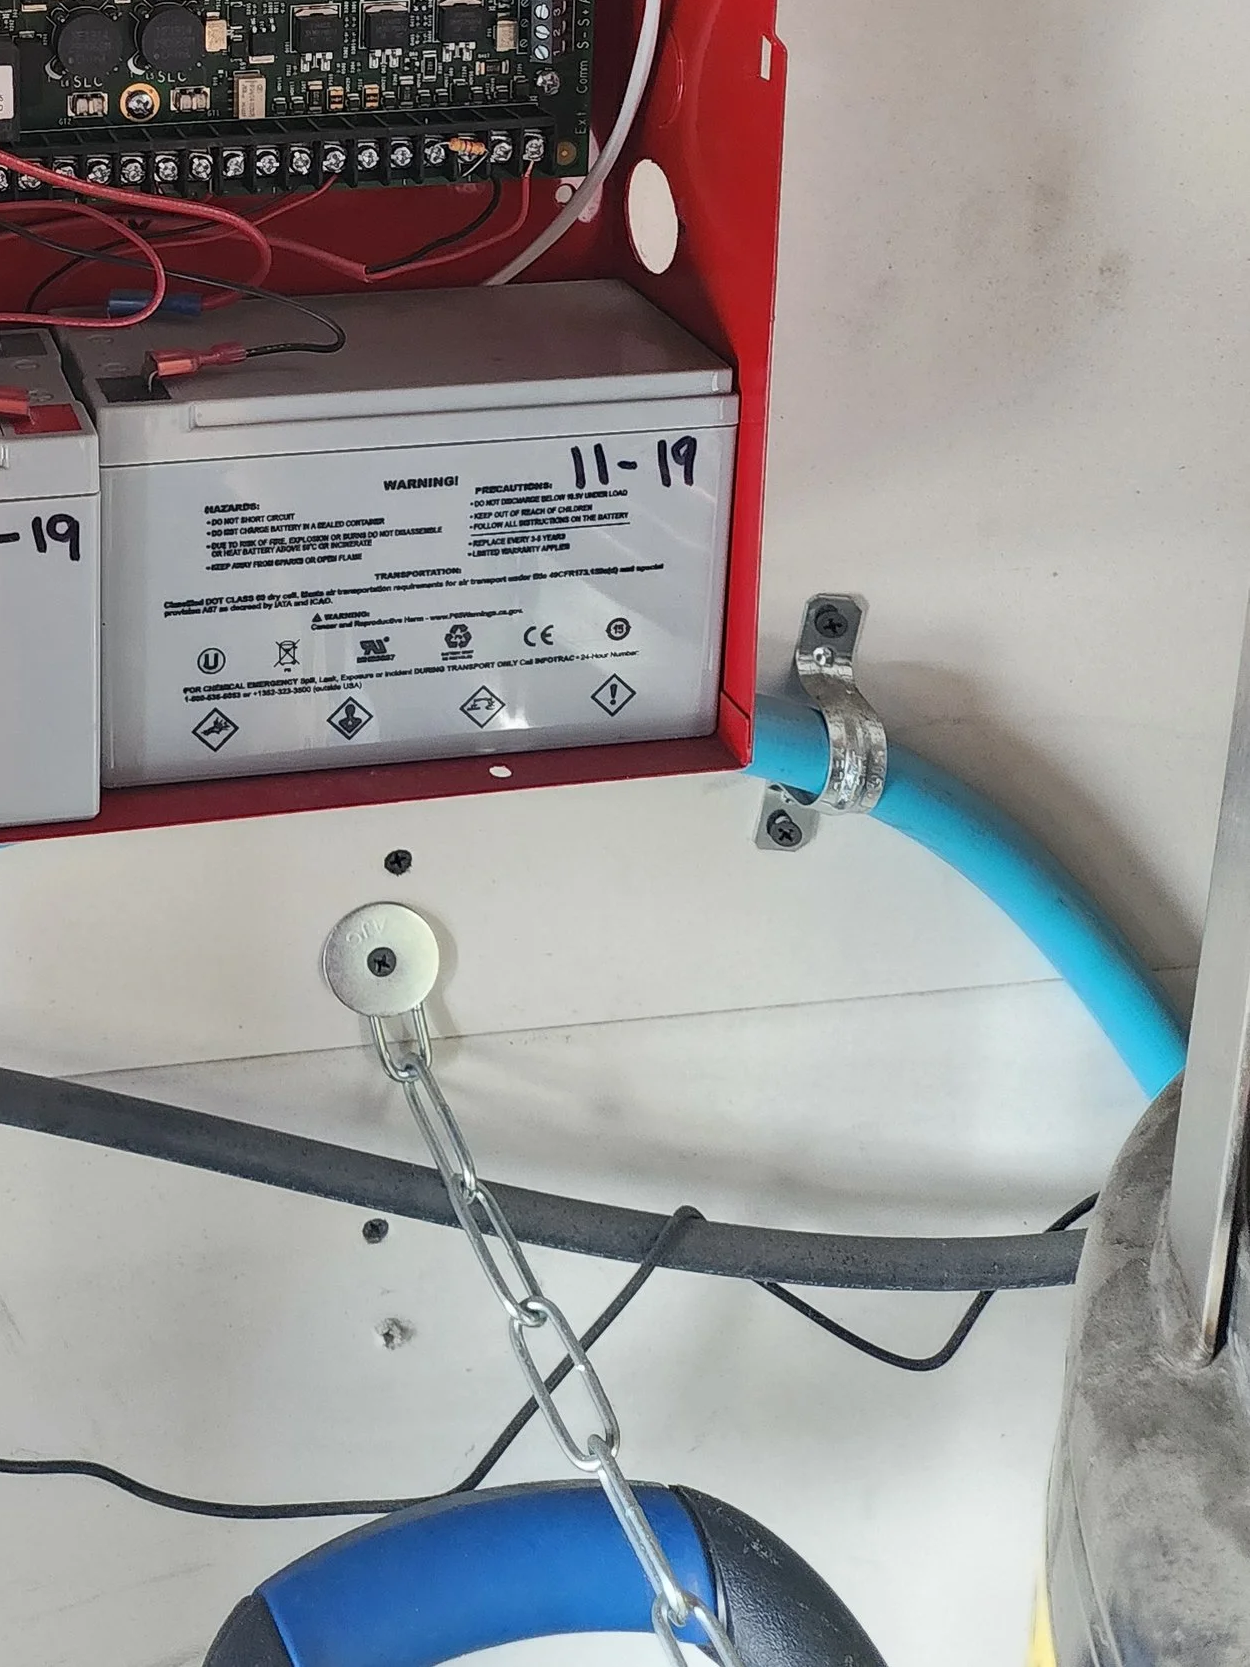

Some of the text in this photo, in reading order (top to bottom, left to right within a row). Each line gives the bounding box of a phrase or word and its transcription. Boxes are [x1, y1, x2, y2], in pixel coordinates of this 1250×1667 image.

[73, 75, 103, 88] SLC
[158, 71, 187, 83] SLC
[576, 60, 589, 94] Comm
[383, 476, 459, 491] WARNING!
[475, 482, 552, 495] PRECAUTIONS:
[204, 502, 260, 514] HAZARDS:
[211, 513, 295, 526] DO NOT SHORT CIRCUIT
